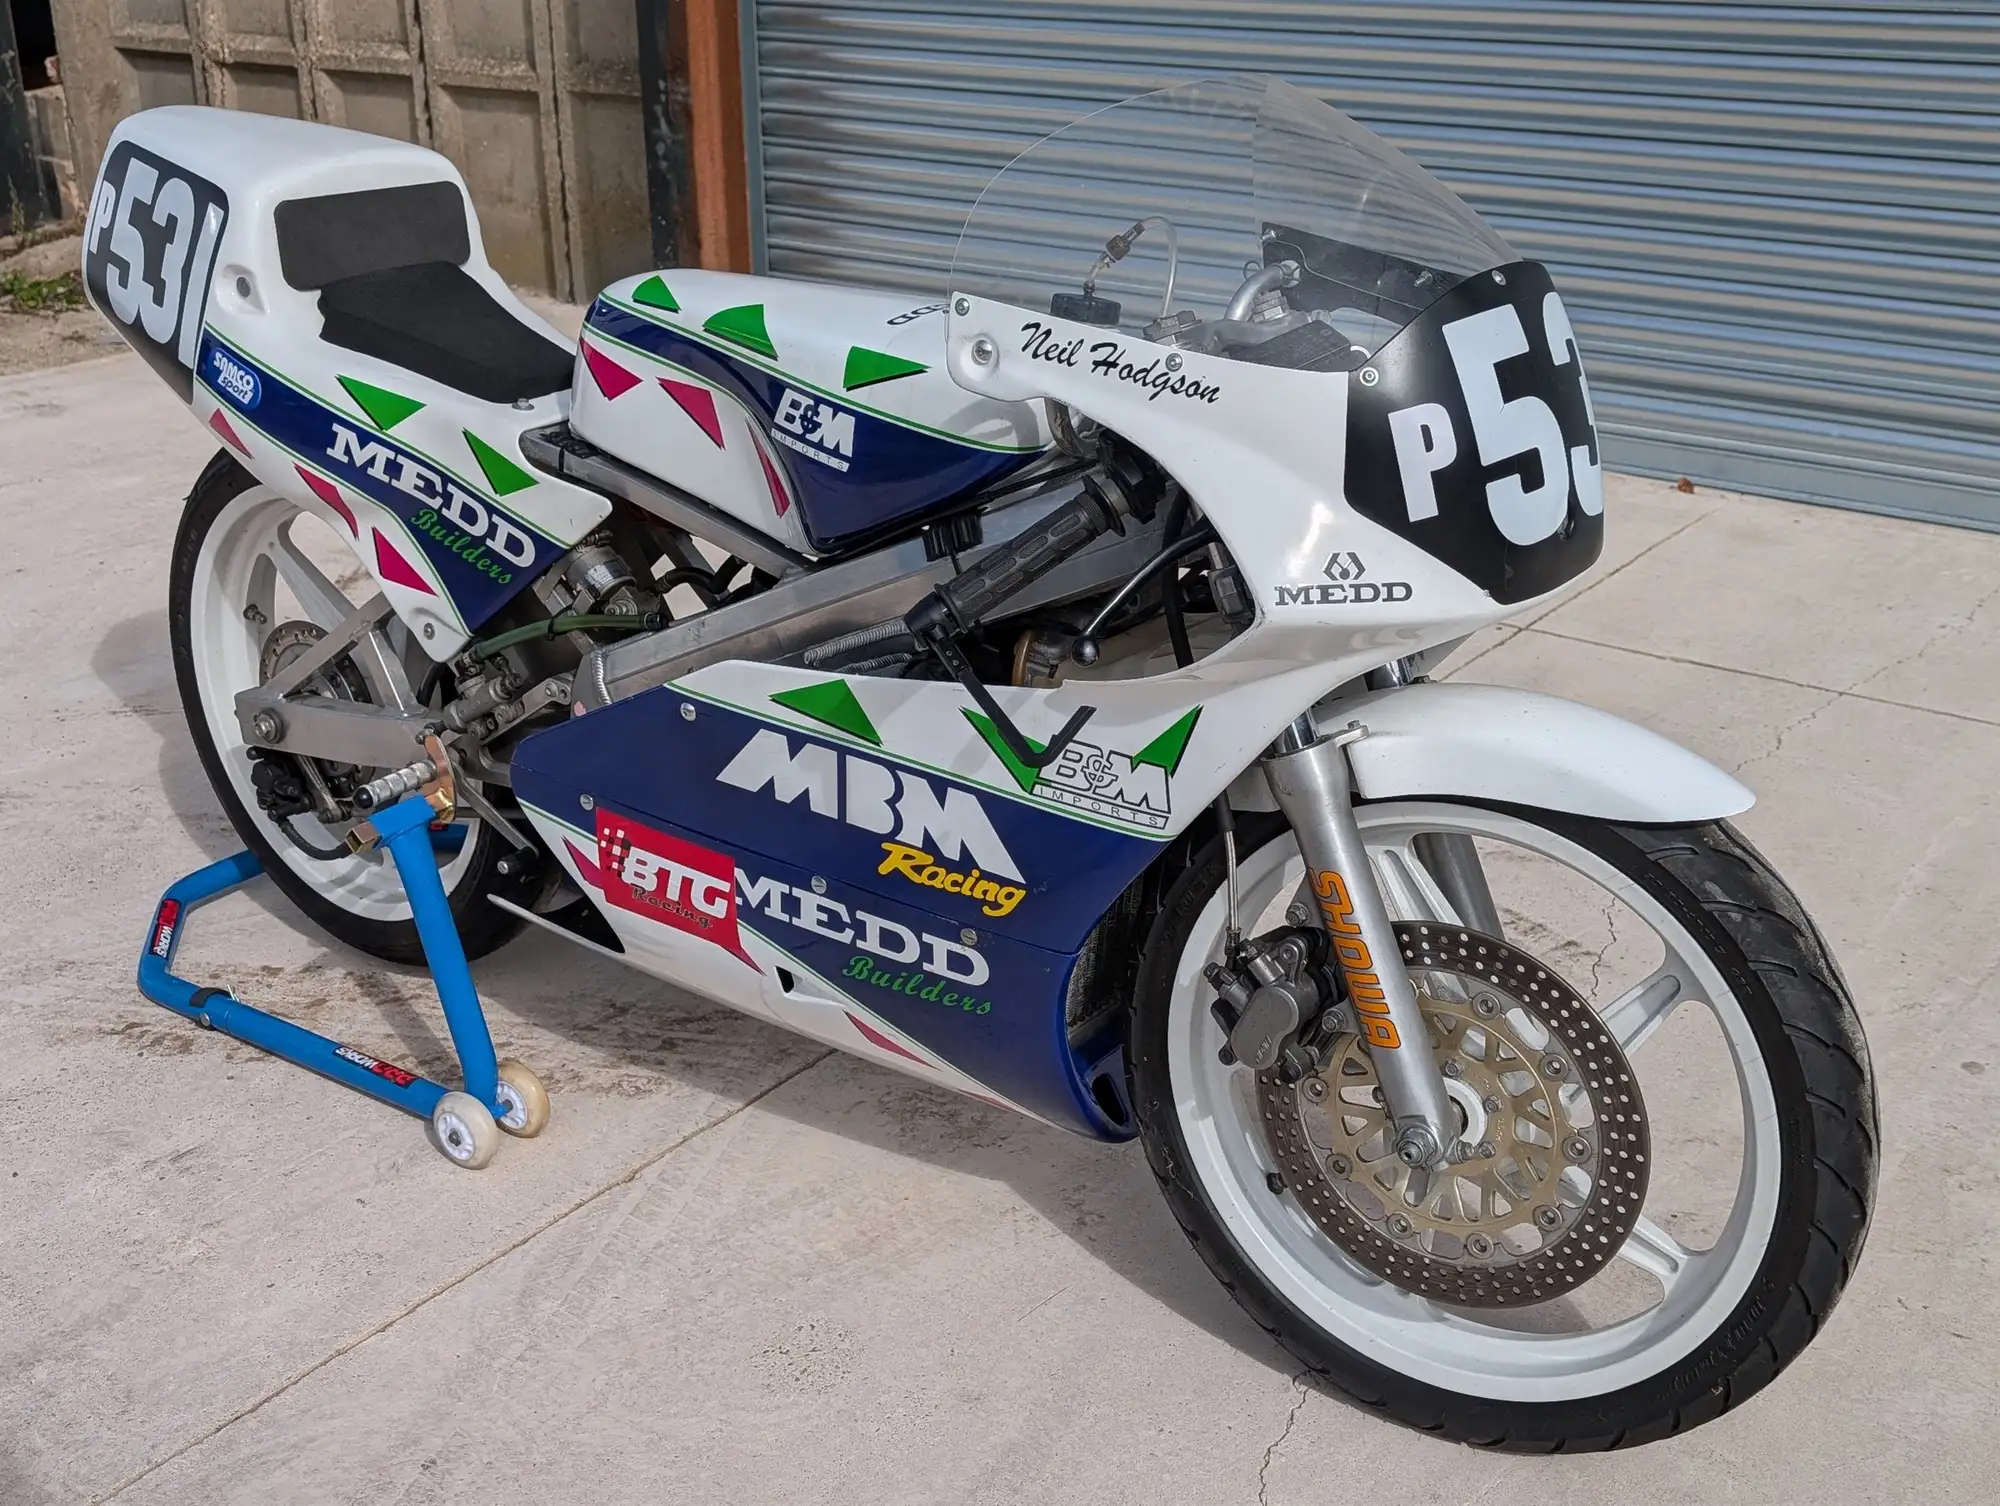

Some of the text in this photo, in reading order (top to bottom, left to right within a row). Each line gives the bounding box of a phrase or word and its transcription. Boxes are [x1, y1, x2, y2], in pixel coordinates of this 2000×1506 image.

[213, 351, 254, 391] SAMCO
[220, 376, 249, 400] sport
[1020, 321, 1221, 404] Neil Hodgson
[772, 430, 845, 470] IMPORTS
[773, 387, 856, 458] B&M
[326, 422, 536, 568] MEDD
[410, 508, 513, 585] Builders
[1274, 582, 1413, 606] MEDD
[716, 728, 1026, 885] MBM
[1035, 739, 1172, 815] B&M
[1039, 786, 1159, 827] IMPORTS
[621, 845, 732, 920] BTG
[631, 886, 714, 930] Racing
[877, 841, 1028, 918] Racing
[734, 866, 990, 987] MEDD
[1307, 866, 1402, 1049] SHOWA
[842, 956, 993, 1016] Builders
